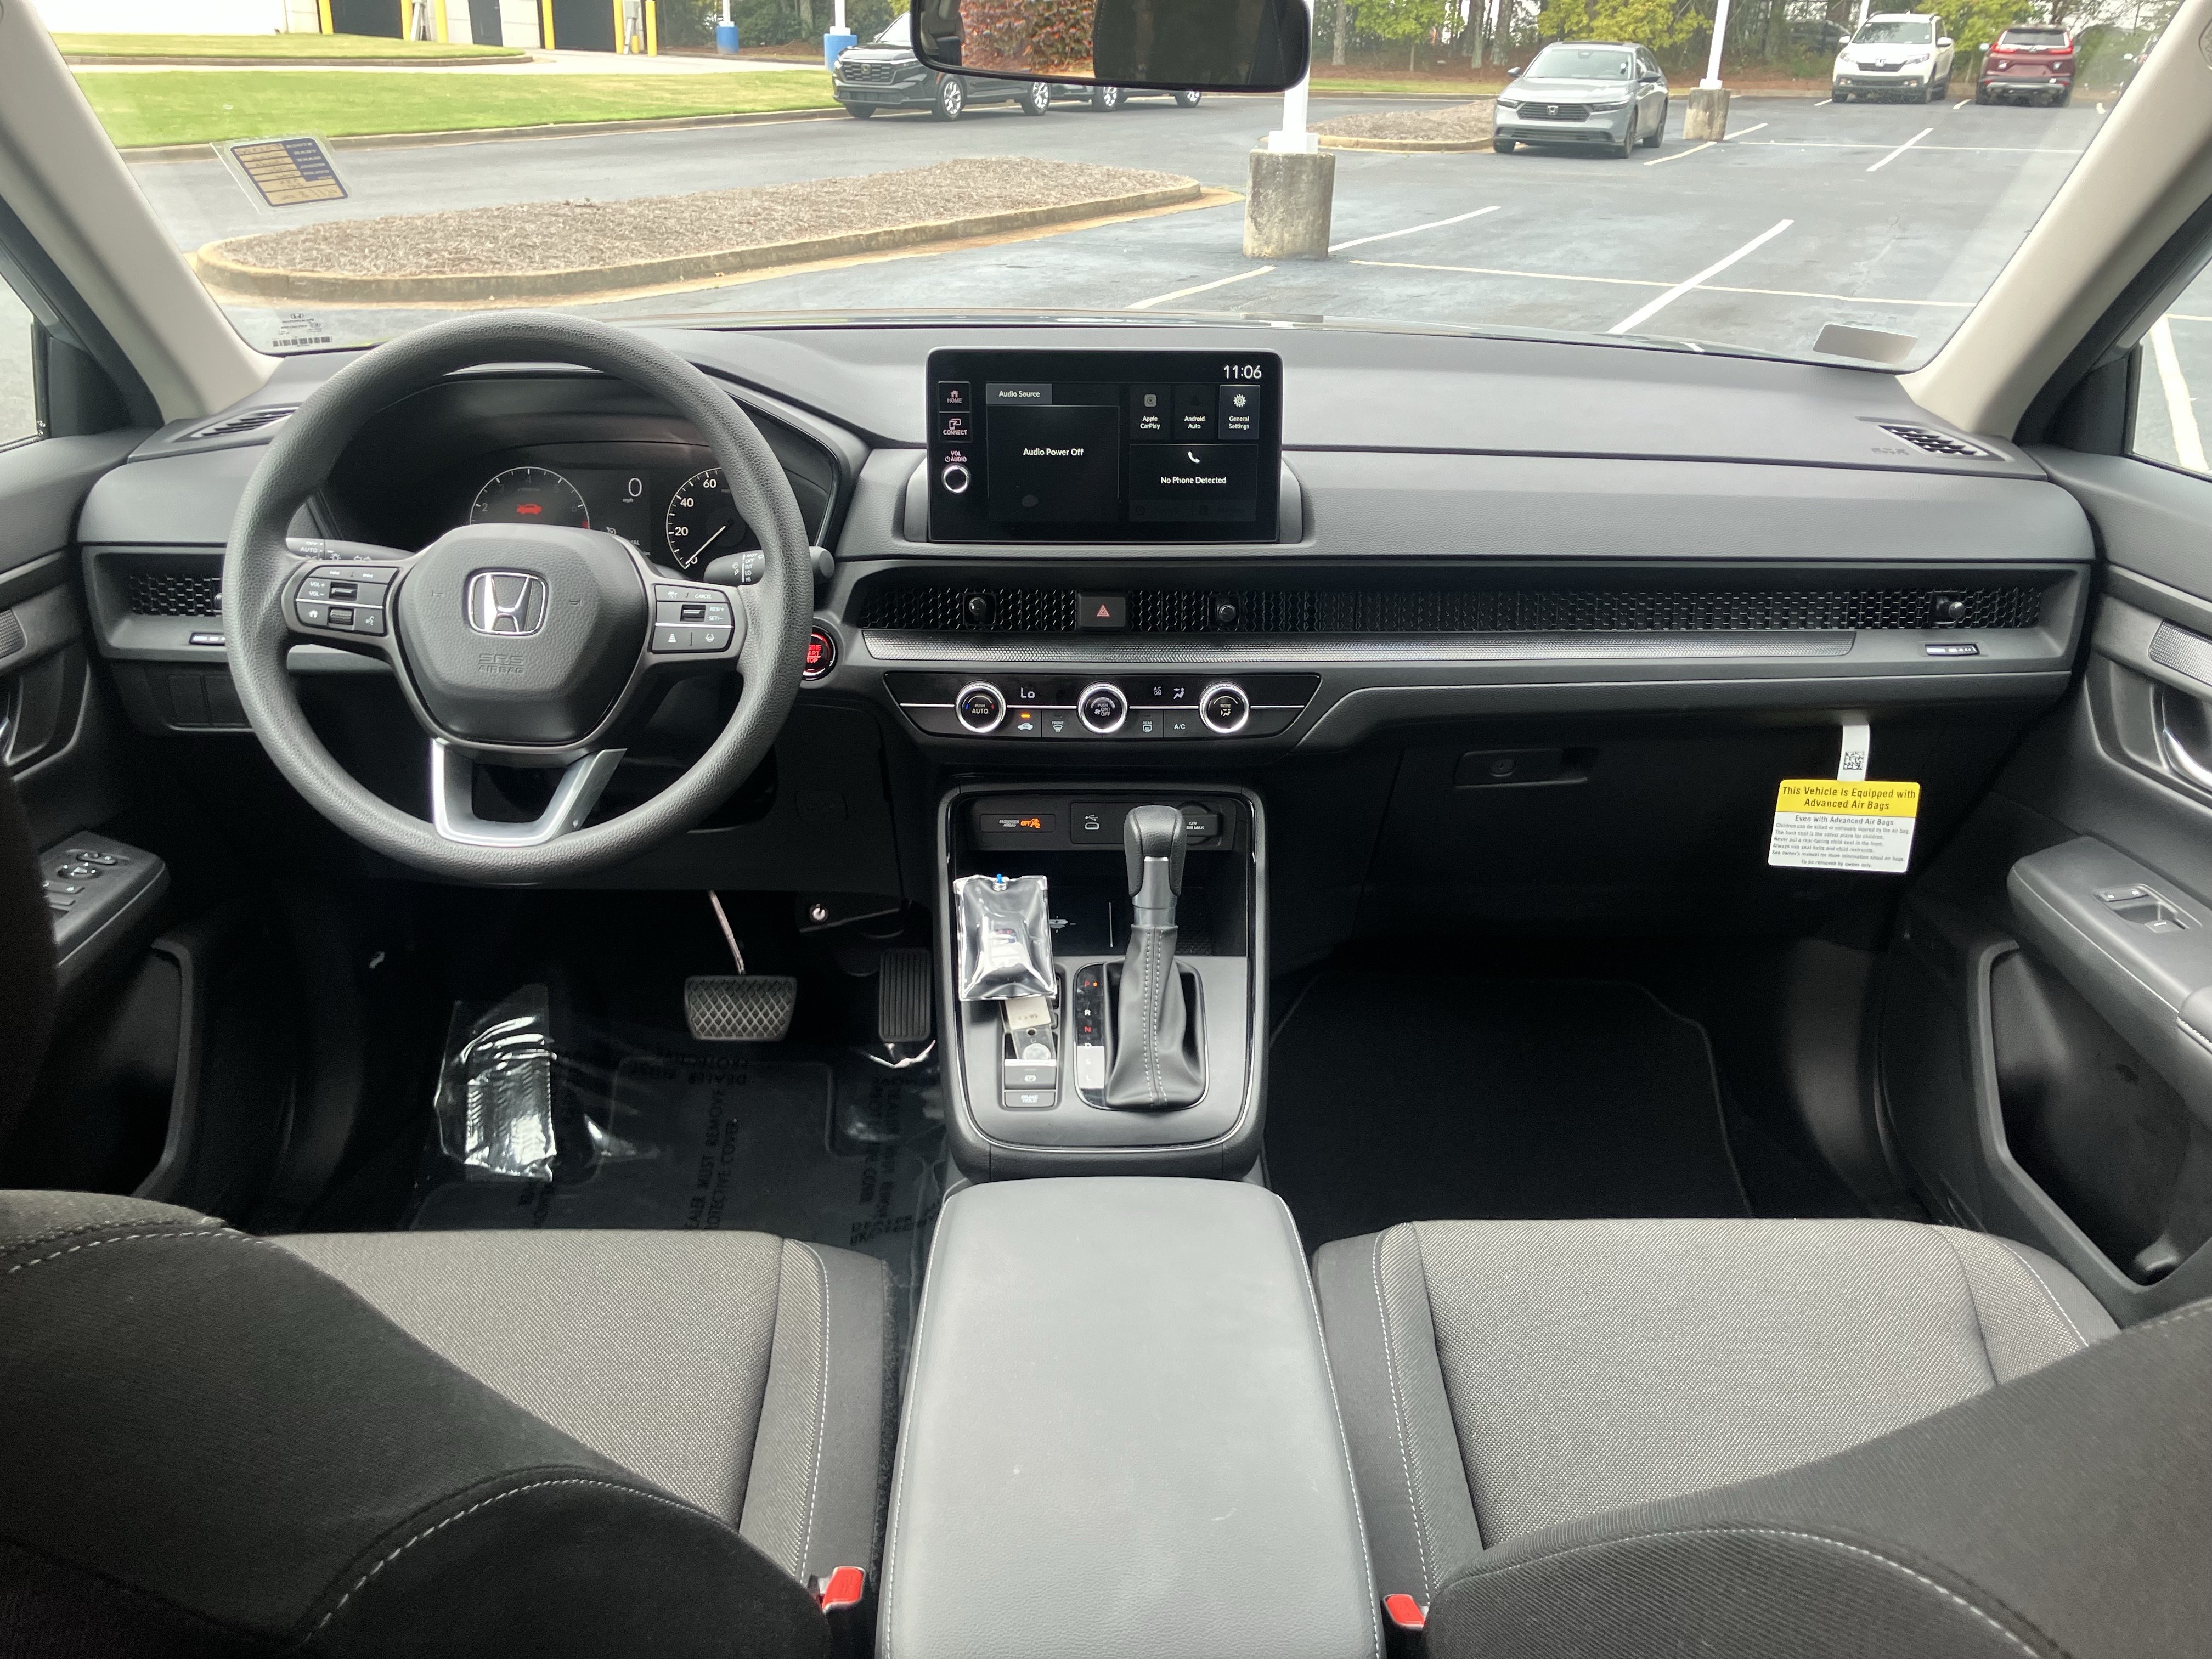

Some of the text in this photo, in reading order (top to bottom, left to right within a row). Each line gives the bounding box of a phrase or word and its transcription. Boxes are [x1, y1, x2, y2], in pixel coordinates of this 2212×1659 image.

[1223, 365, 1262, 379] 11:06
[1023, 448, 1084, 456] Audio Power Off
[628, 477, 642, 497] 0
[703, 478, 717, 488] 60
[482, 503, 488, 512] 2
[680, 498, 694, 507] 40
[675, 527, 689, 536] 20
[1020, 687, 1035, 698] Lo
[1782, 786, 1801, 794] This
[1804, 786, 1837, 796] Vehicle
[1852, 788, 1893, 799] Equipped
[1897, 790, 1916, 798] with
[1804, 799, 1889, 811] Advanced Air Bags
[705, 1170, 732, 1229] OTECTIVE
[686, 1196, 706, 1229] EALER
